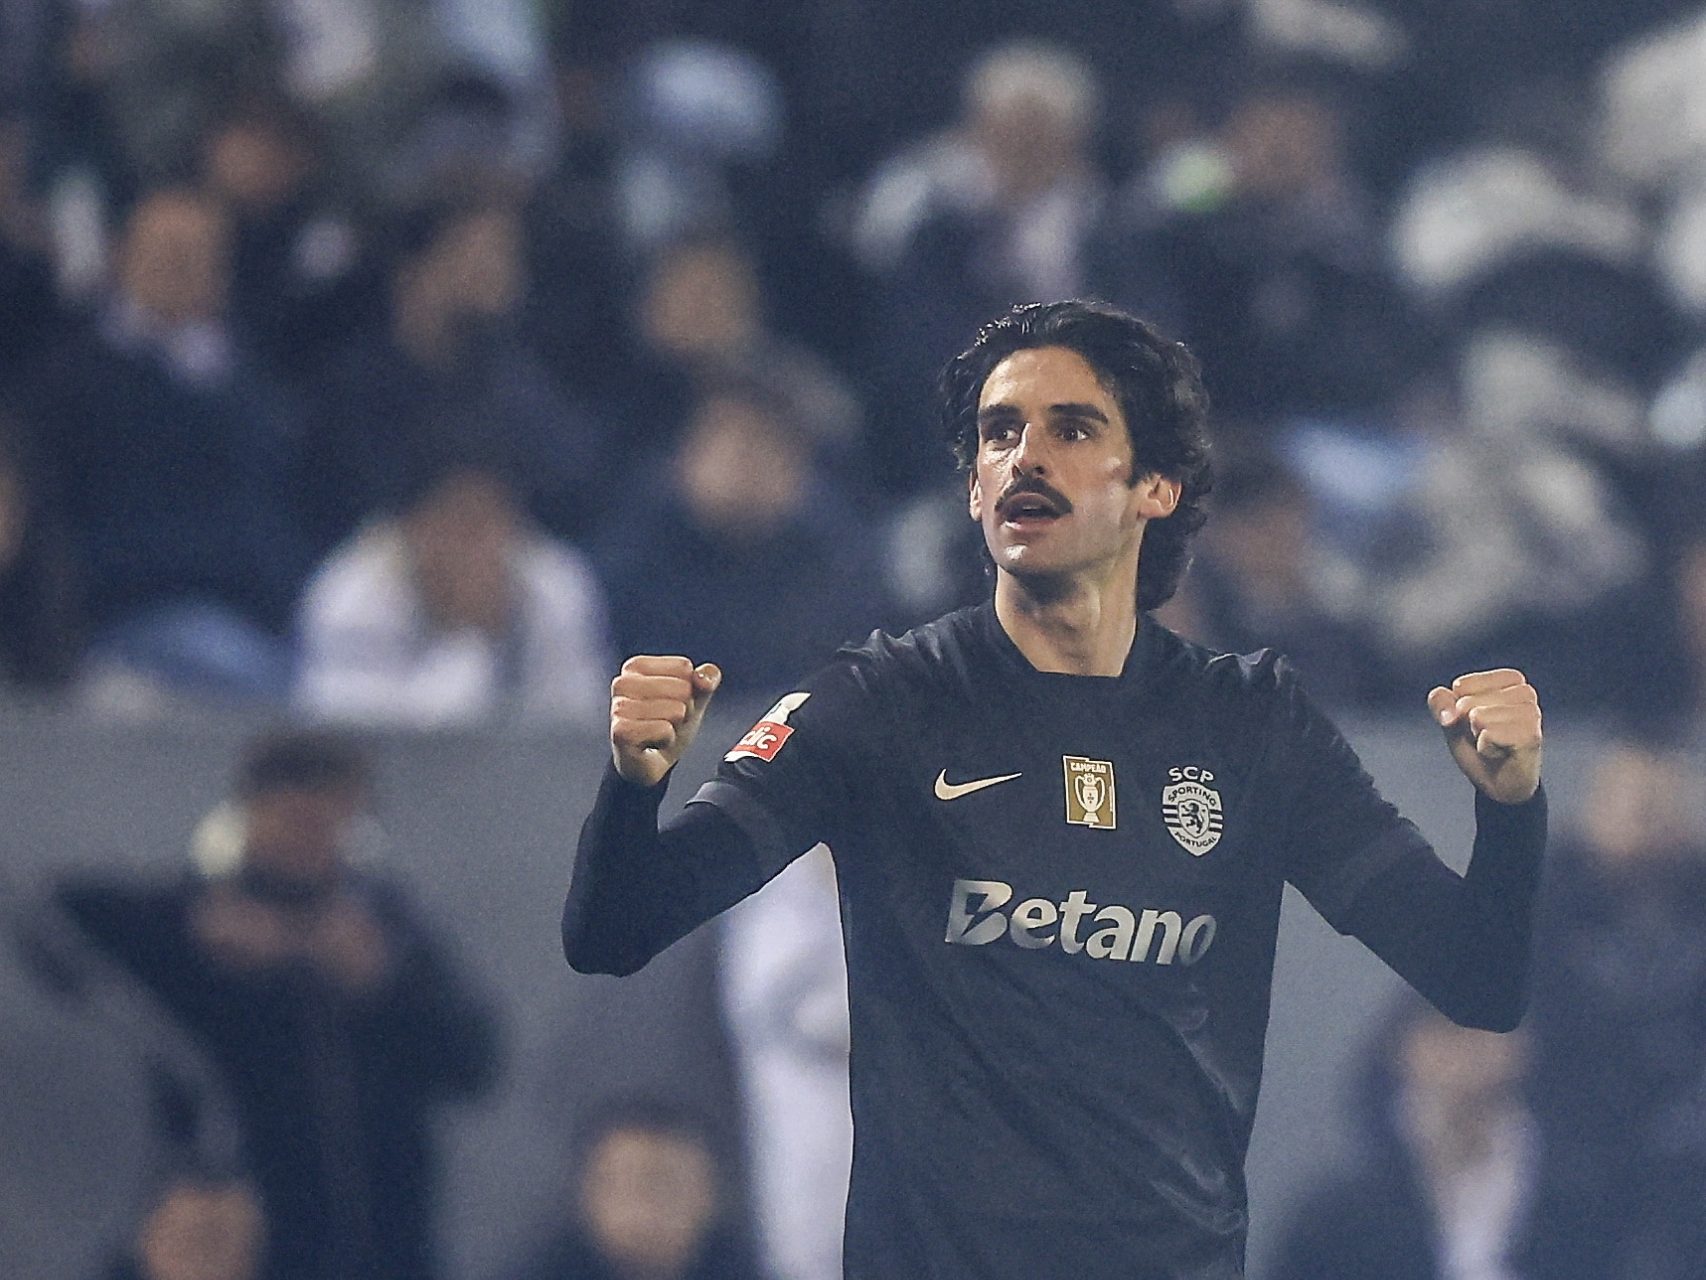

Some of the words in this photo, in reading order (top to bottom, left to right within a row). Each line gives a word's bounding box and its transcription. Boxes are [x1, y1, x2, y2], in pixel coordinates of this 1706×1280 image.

[1168, 766, 1214, 783] SCP
[1168, 786, 1217, 807] SPORTING
[1174, 830, 1218, 848] PORTUGAL
[945, 879, 1217, 965] Betano
